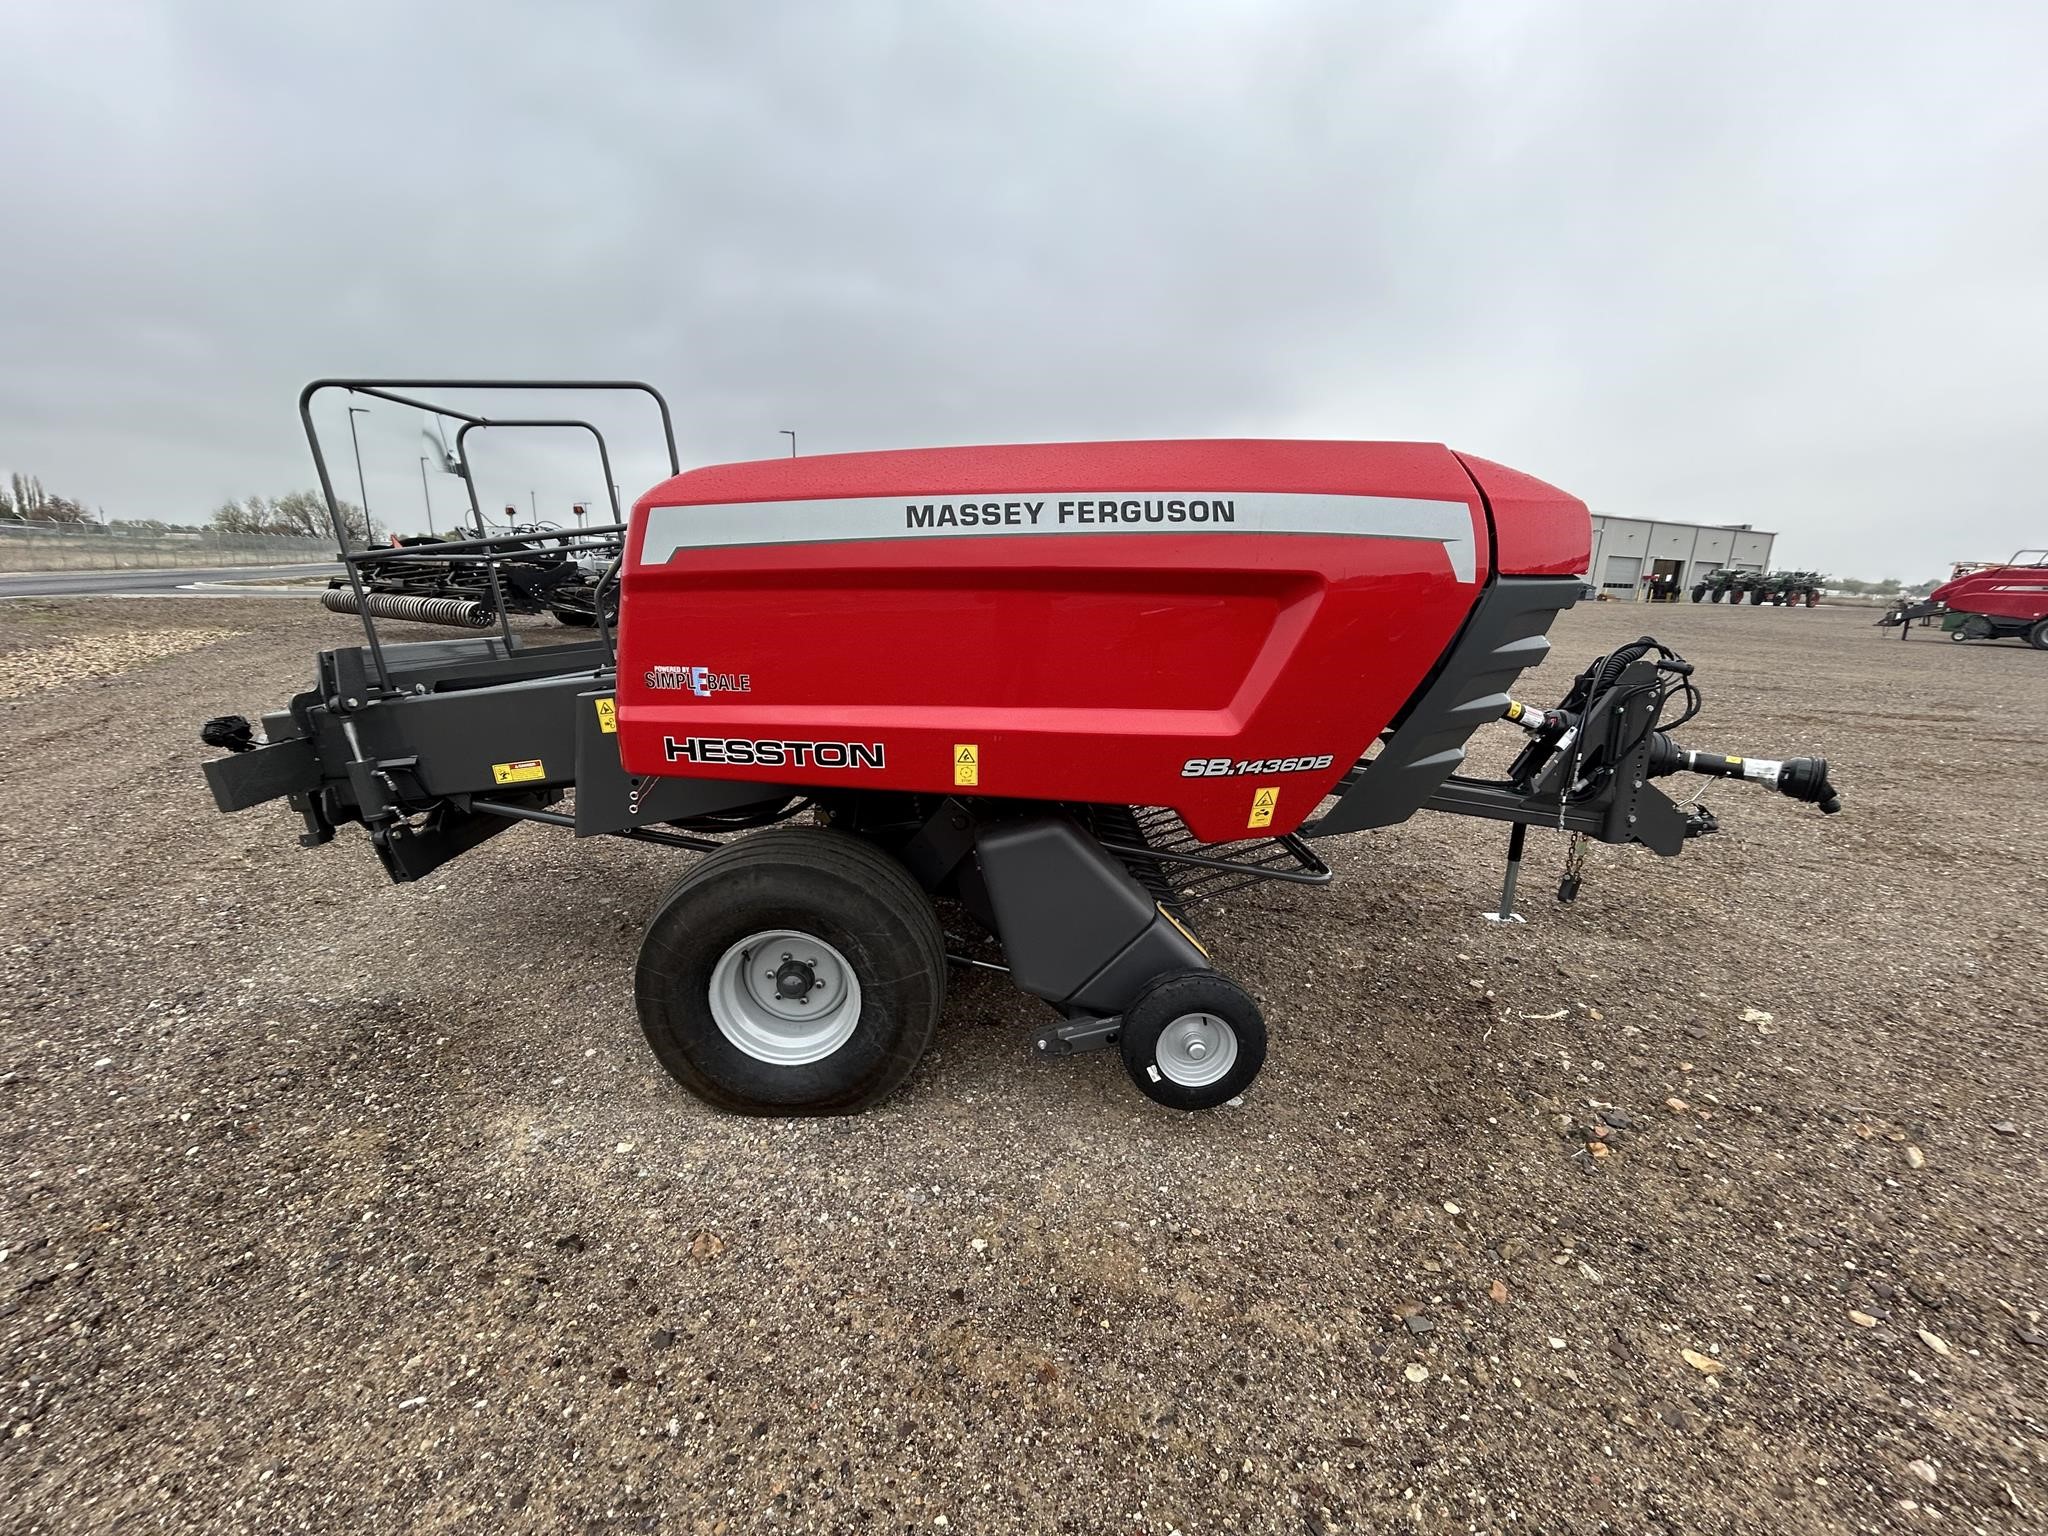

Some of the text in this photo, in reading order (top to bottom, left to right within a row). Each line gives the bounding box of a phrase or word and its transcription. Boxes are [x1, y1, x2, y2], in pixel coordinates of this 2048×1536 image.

[906, 500, 1235, 528] MASSEY FERGUSON
[664, 736, 885, 768] HESSTON
[1181, 755, 1334, 777] SB.1436DB
